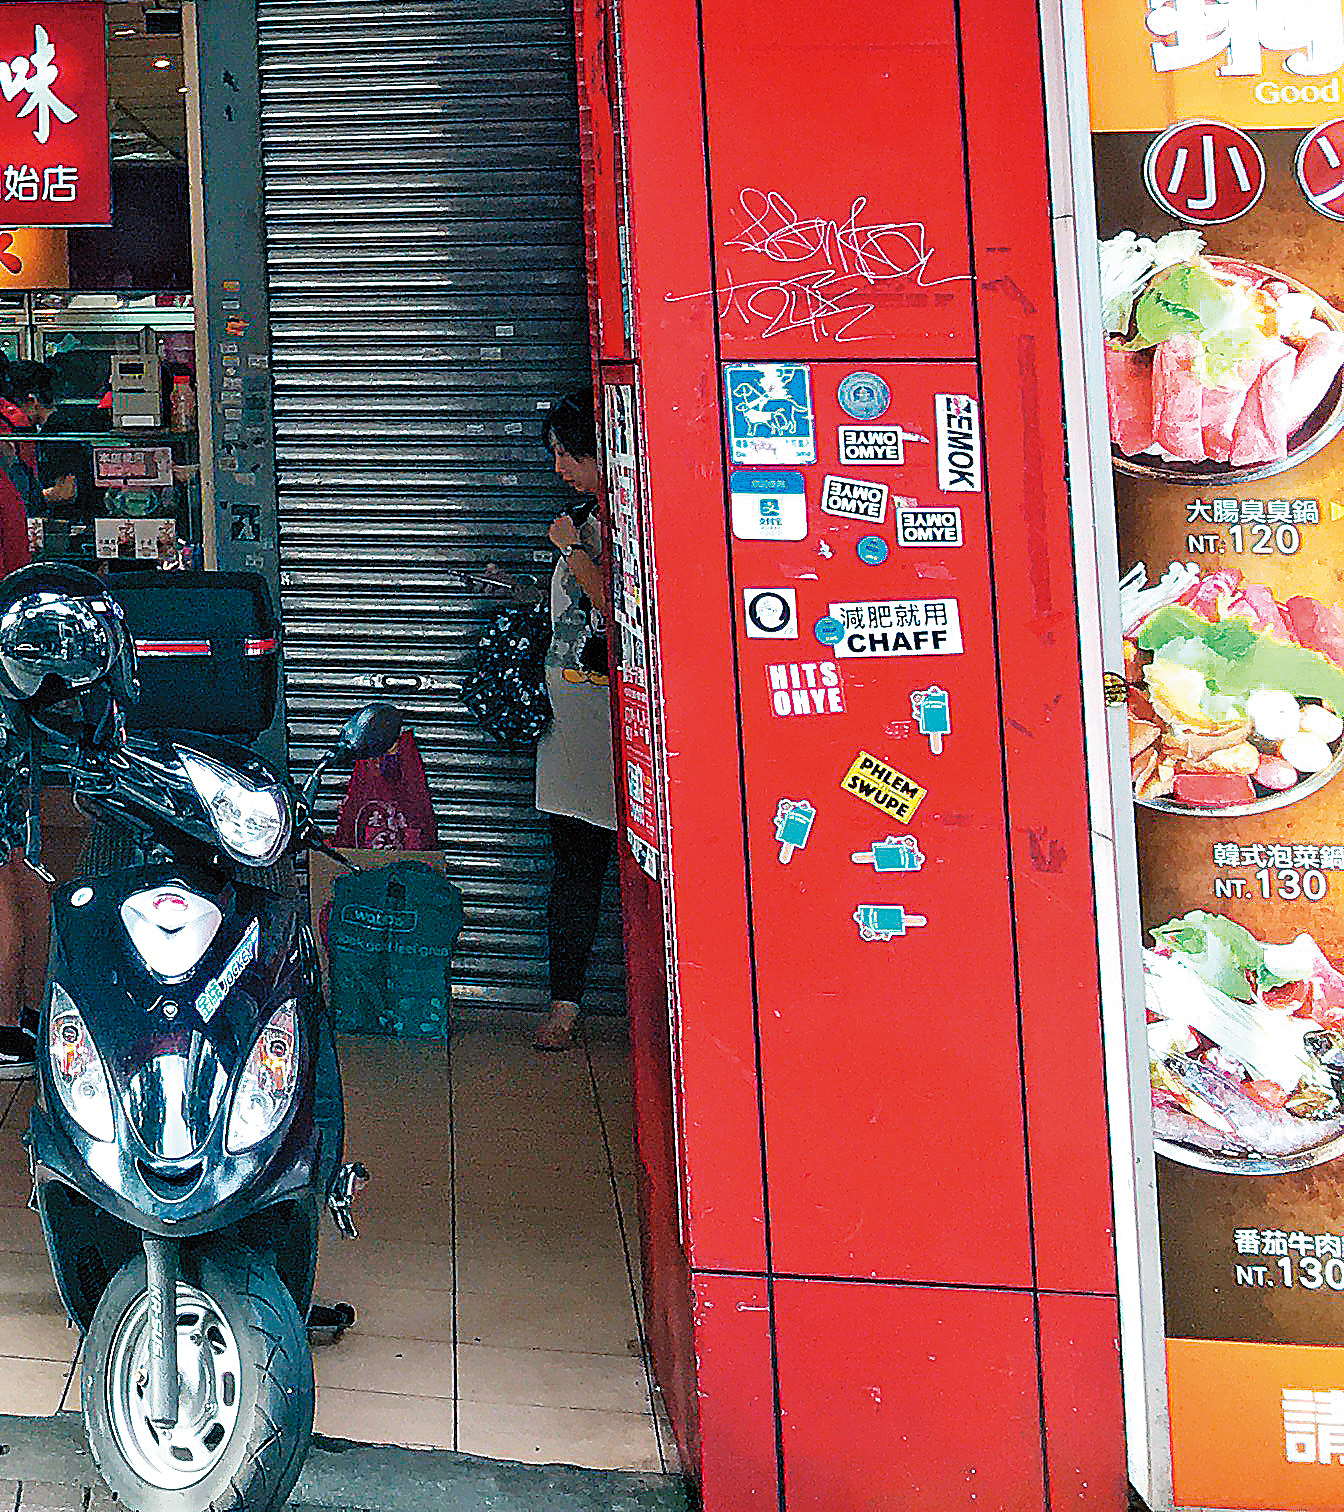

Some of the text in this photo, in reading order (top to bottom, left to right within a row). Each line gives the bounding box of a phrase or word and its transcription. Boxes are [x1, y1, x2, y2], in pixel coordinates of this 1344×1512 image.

[1255, 78, 1340, 104] Good
[845, 431, 897, 445] OMYE
[845, 445, 899, 459] OMYE
[828, 495, 880, 517] OMYE
[1186, 499, 1319, 525] 大腸臭臭鍋
[902, 512, 955, 527] OMYE
[904, 526, 957, 541] OMYE
[840, 603, 947, 629] 減肥就用
[847, 630, 947, 653] CHAFF
[769, 661, 839, 690] HITS
[859, 757, 919, 799] PHLEM
[847, 776, 910, 818] SWUPE
[1233, 1228, 1344, 1256] 番茄牛肉
